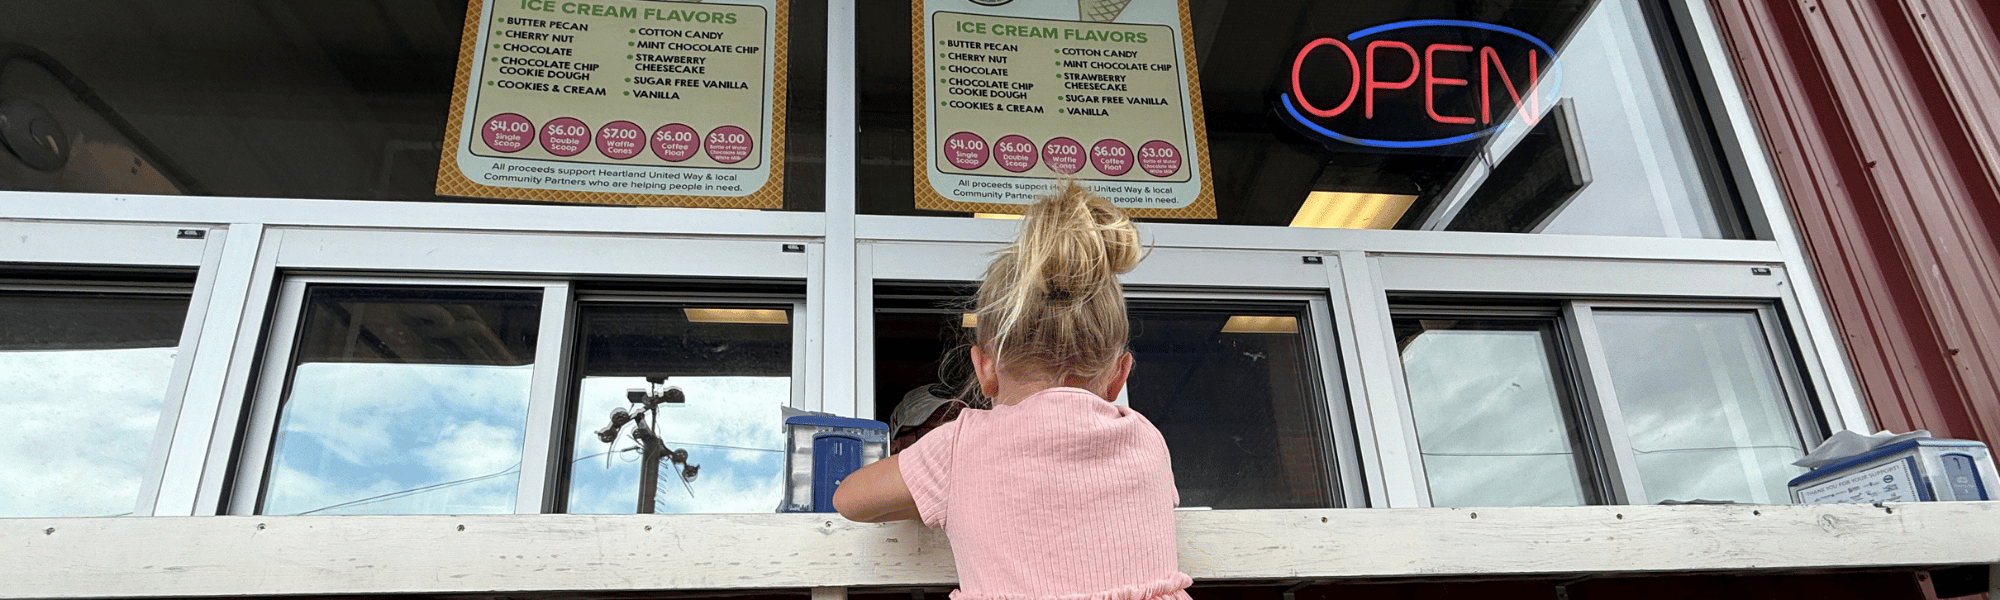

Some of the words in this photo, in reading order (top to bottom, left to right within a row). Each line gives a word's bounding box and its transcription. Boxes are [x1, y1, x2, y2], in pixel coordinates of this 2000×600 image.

[520, 0, 554, 12] ICE
[562, 1, 637, 18] CREAM
[644, 8, 737, 25] FLAVORS
[507, 17, 546, 28] BUTTER
[549, 21, 588, 31] PECAN
[505, 30, 549, 42] CHERRY
[553, 34, 574, 43] NUT
[639, 28, 682, 38] COTTON
[685, 30, 723, 39] CANDY
[956, 21, 987, 35] ICE
[992, 23, 1058, 39] CREAM
[1064, 29, 1148, 43] FLAVORS
[503, 43, 573, 56] CHOCOLATE
[637, 41, 665, 50] MINT
[668, 42, 732, 53] CHOCOLATE
[735, 45, 759, 54] CHIP
[948, 40, 981, 50] BUTTER
[985, 43, 1018, 52] PECAN
[948, 53, 985, 63] CHERRY
[1062, 48, 1101, 56] COTTON
[1103, 50, 1137, 58] CANDY
[501, 57, 570, 69] CHOCOLATE
[574, 62, 599, 71] CHIP
[636, 54, 706, 64] STRAWBERRY
[635, 63, 705, 74] CHEESECAKE
[949, 65, 1008, 76] CHOCOLATE
[1064, 60, 1088, 68] MINT
[1091, 61, 1148, 70] CHOCOLATE
[1151, 63, 1171, 71] CHIP
[499, 67, 544, 77] COOKIE
[547, 70, 590, 80] DOUGH
[1064, 73, 1126, 83] STRAWBERRY
[634, 77, 672, 87] SUGAR
[675, 79, 699, 88] FREE
[702, 80, 748, 89] VANILLA
[949, 78, 1009, 89] CHOCOLATE
[1064, 82, 1127, 92] CHEESECAKE
[1292, 37, 1539, 126] OPEN
[497, 80, 549, 92] COOKIES
[552, 84, 559, 92] &
[562, 85, 606, 95] CREAM
[633, 90, 680, 100] VANILLA
[949, 88, 988, 97] COOKIE
[990, 91, 1027, 100] DOUGH
[1066, 95, 1100, 104] SUGAR
[1102, 96, 1125, 104] FREE
[1127, 97, 1168, 105] VANILLA
[950, 101, 994, 111] COOKIES
[1006, 105, 1044, 114] CREAM
[1067, 108, 1109, 116] VANILLA
[490, 120, 529, 133] $4.00
[549, 125, 585, 137] $6.00
[495, 133, 521, 142] Single
[603, 128, 637, 140] $7.00
[657, 130, 692, 143] $6.00
[710, 133, 744, 144] $3.00
[494, 140, 520, 149] Scoop
[550, 137, 579, 146] Double
[607, 140, 634, 149] Waffle
[662, 142, 688, 151] Coffee
[950, 139, 983, 151] $4.00
[551, 143, 577, 153] Scoop
[608, 146, 632, 155] Cones
[664, 149, 684, 157] Float
[1000, 142, 1031, 153] $6.00
[1048, 144, 1077, 155] $7.00
[1094, 146, 1126, 157] $6.00
[1142, 148, 1173, 158] $3.00
[956, 151, 978, 159] Single
[956, 157, 979, 165] Scoop
[1005, 160, 1027, 168] Scoop
[492, 163, 505, 171] All
[508, 164, 555, 175] proceeds
[558, 167, 595, 177] support
[599, 169, 646, 178] Heartland
[649, 171, 680, 179] United
[683, 173, 703, 182] Way
[706, 173, 712, 181] &
[716, 173, 736, 181] local
[484, 173, 541, 185] Community
[545, 175, 586, 186] Partners
[589, 179, 609, 187] who
[612, 180, 628, 188] are
[631, 180, 666, 191] helping
[669, 183, 702, 192] people
[715, 184, 742, 192] need.
[959, 179, 970, 187] All
[972, 180, 1013, 190] proceeds
[1015, 183, 1047, 192] support
[1094, 185, 1122, 193] United
[1124, 186, 1142, 194] Way
[953, 189, 1002, 200] Community
[1005, 192, 1039, 200] Partner
[1114, 196, 1143, 204] people
[1807, 488, 1825, 496] THANK
[1851, 475, 1867, 483] YOUR
